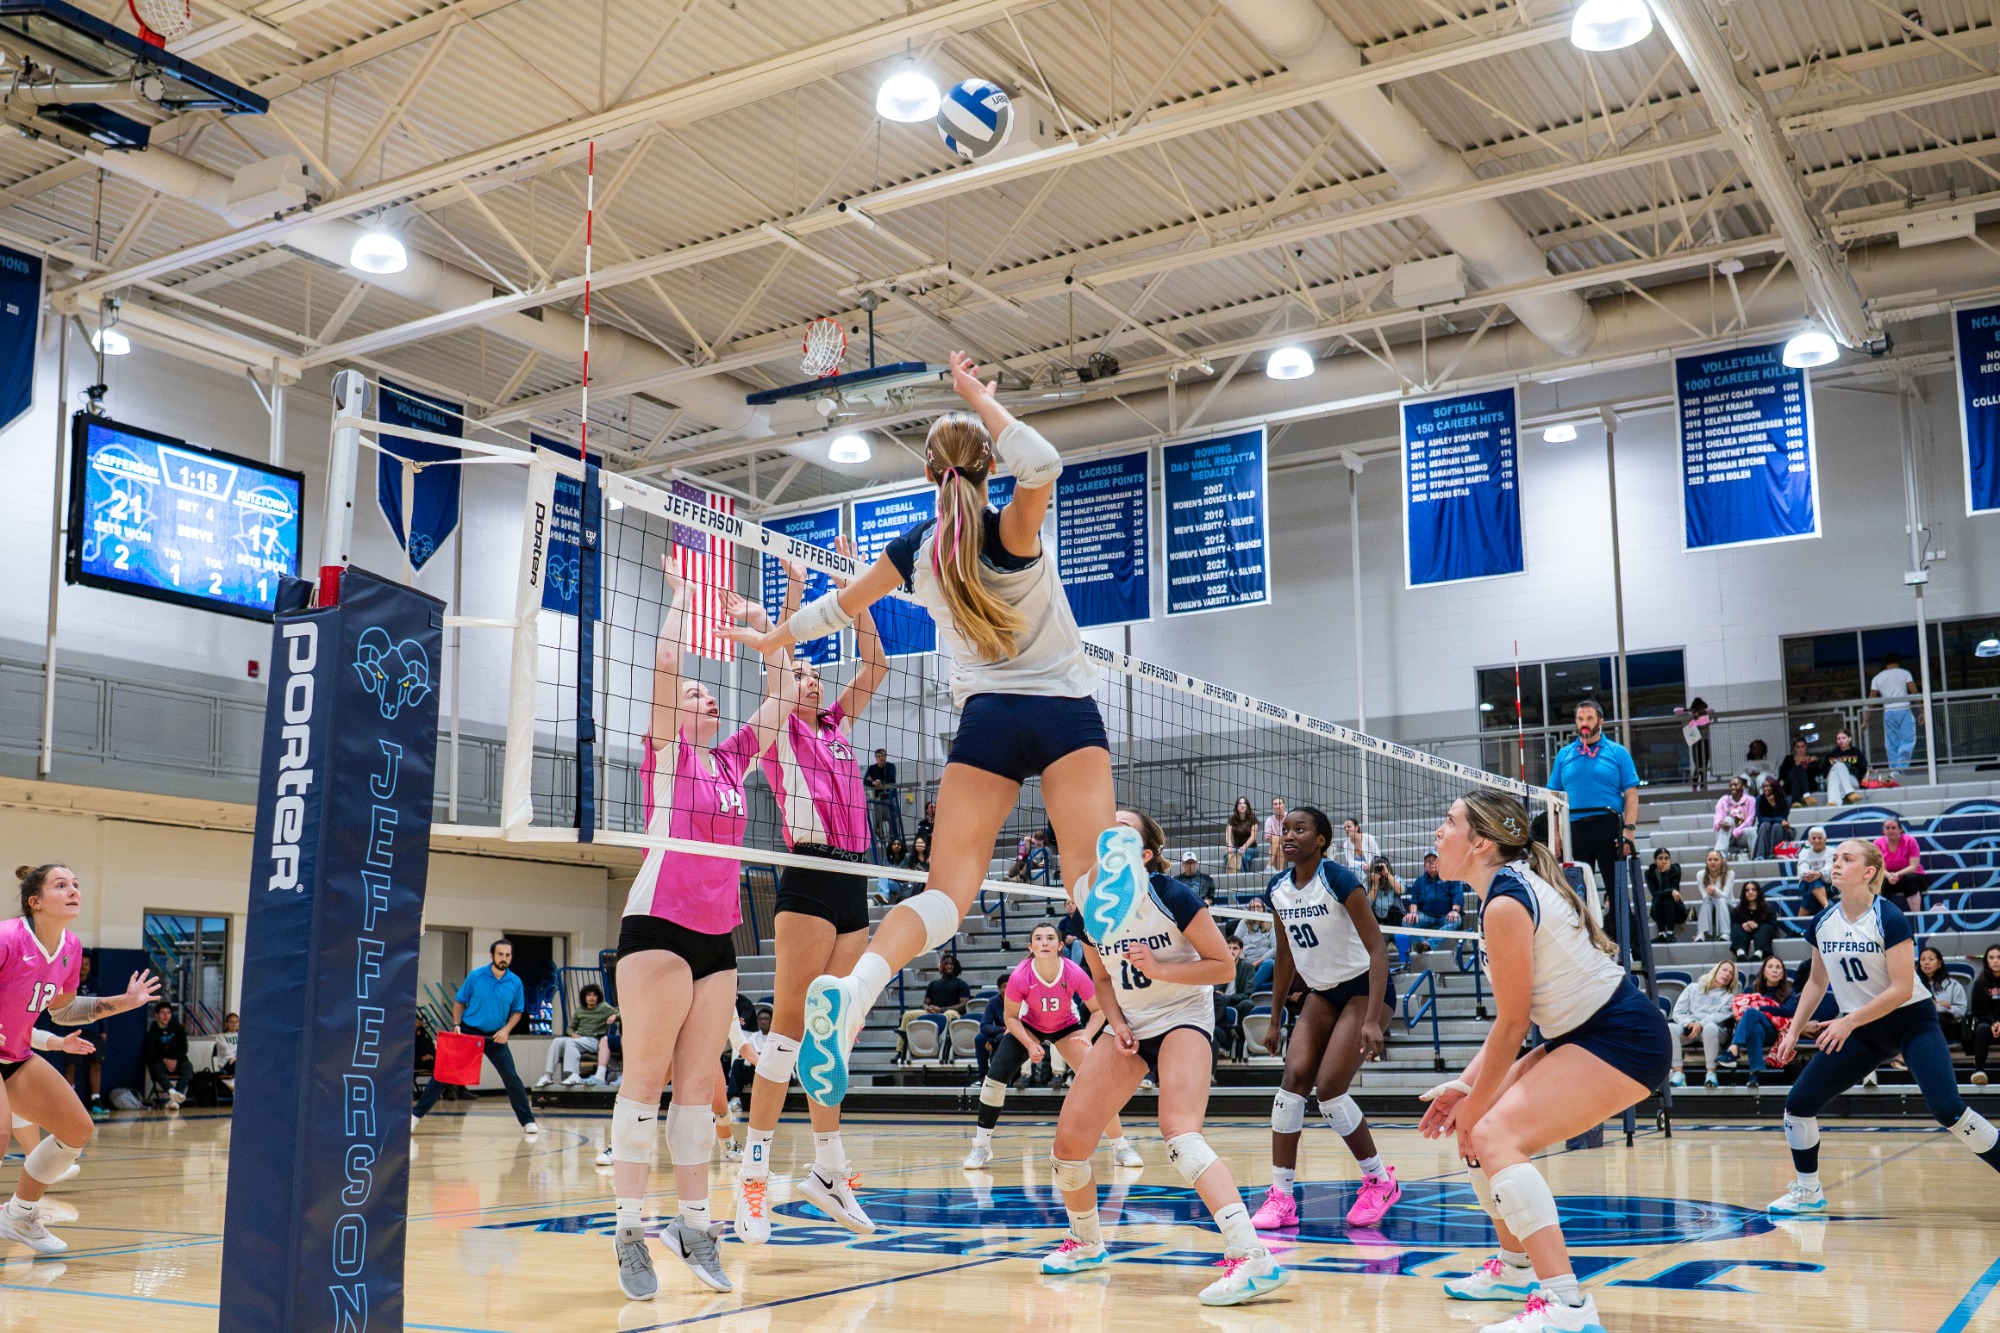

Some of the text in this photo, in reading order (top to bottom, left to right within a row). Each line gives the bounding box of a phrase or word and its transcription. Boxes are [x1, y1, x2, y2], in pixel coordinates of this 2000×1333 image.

[1702, 352, 1776, 374] VOLLEYBALL
[1684, 366, 1796, 391] 1000 CAREER KILLS
[1704, 392, 1729, 404] ASHLEY
[1731, 386, 1776, 399] COLANTONIO
[1434, 401, 1486, 418] SOFTBALL
[1704, 405, 1724, 415] EMILY
[1726, 400, 1754, 412] KRAUSS
[1416, 412, 1504, 434] 150 CAREER HITS
[1704, 416, 1731, 426] CELENA
[1733, 410, 1762, 422] RENDON
[1428, 436, 1452, 448] ASHLEY
[1454, 431, 1489, 443] STAPLETON
[1705, 426, 1730, 438] NICOLE
[1706, 438, 1737, 449] CHELSEA
[1738, 433, 1768, 444] HUGHES
[1194, 444, 1232, 458] ROWING
[1429, 449, 1441, 458] JEN
[1442, 444, 1470, 456] RICHARD
[1461, 454, 1480, 464] LEWIS
[1706, 448, 1746, 460] COURTNEY
[97, 453, 159, 478] JEFFERSON
[1170, 451, 1256, 472] DAD VAIL REGATTA
[1707, 460, 1737, 472] MORGAN
[1738, 456, 1766, 468] RITCHIE
[180, 466, 218, 493] 1:15
[1079, 464, 1124, 479] LACROSSE
[1191, 466, 1236, 481] MEDALIST
[1429, 468, 1464, 478] SAMANTHA
[1708, 472, 1725, 483] JESS
[1060, 474, 1144, 494] 200 CAREER POINTS
[1204, 484, 1224, 495] 2007
[1430, 478, 1464, 489] STEPHANIE
[1466, 474, 1490, 484] MARTIN
[236, 489, 288, 513] KUTZTOWN
[1173, 498, 1202, 510] WOMEN'S
[1204, 494, 1227, 506] NOVICE
[1236, 490, 1256, 500] GOLD
[1430, 490, 1452, 500] NAOMI
[1453, 488, 1470, 498] STAS
[109, 490, 142, 524] 21
[205, 507, 214, 522] 4
[875, 502, 914, 516] BASEBALL
[1074, 507, 1094, 516] ASHLEY
[1204, 509, 1224, 520] 2010
[664, 495, 744, 537] JEFFERSON
[862, 510, 928, 530] 200 CAREER HITS
[785, 520, 814, 532] SOCCER
[809, 528, 836, 540] POINTS
[1074, 526, 1093, 535] TAYLOR
[1174, 525, 1194, 535] MEN'S
[1195, 520, 1222, 532] VARSITY
[1230, 516, 1254, 526] SILVER
[124, 526, 152, 543] WON
[248, 524, 278, 555] 17
[1205, 534, 1226, 546] 2012
[113, 544, 130, 571] 2
[787, 538, 855, 575] JEFFERSON
[1170, 550, 1198, 560] WOMEN'S
[1199, 546, 1226, 556] VARSITY
[1235, 539, 1262, 551] BRONZE
[263, 560, 288, 574] WON
[1206, 559, 1226, 570] 2021
[170, 563, 180, 587] 1
[1172, 575, 1201, 586] WOMEN'S
[1202, 570, 1228, 582] VARSITY
[1238, 565, 1262, 576] SILVER
[208, 572, 222, 596] 2
[257, 578, 268, 602] 1
[1207, 584, 1227, 596] 2022
[1172, 591, 1263, 611] WOMEN'S VARSITY SILVER
[1138, 660, 1178, 684] JEFFERSON
[1203, 682, 1238, 704] JEFFERSON
[1256, 700, 1288, 720] JEFFERSON
[1290, 923, 1319, 948] 20
[1120, 960, 1152, 990] 18
[1839, 957, 1868, 982] 10
[26, 981, 57, 1013] 12
[1041, 997, 1060, 1012] 13
[330, 738, 403, 1333] JEFFERSON
